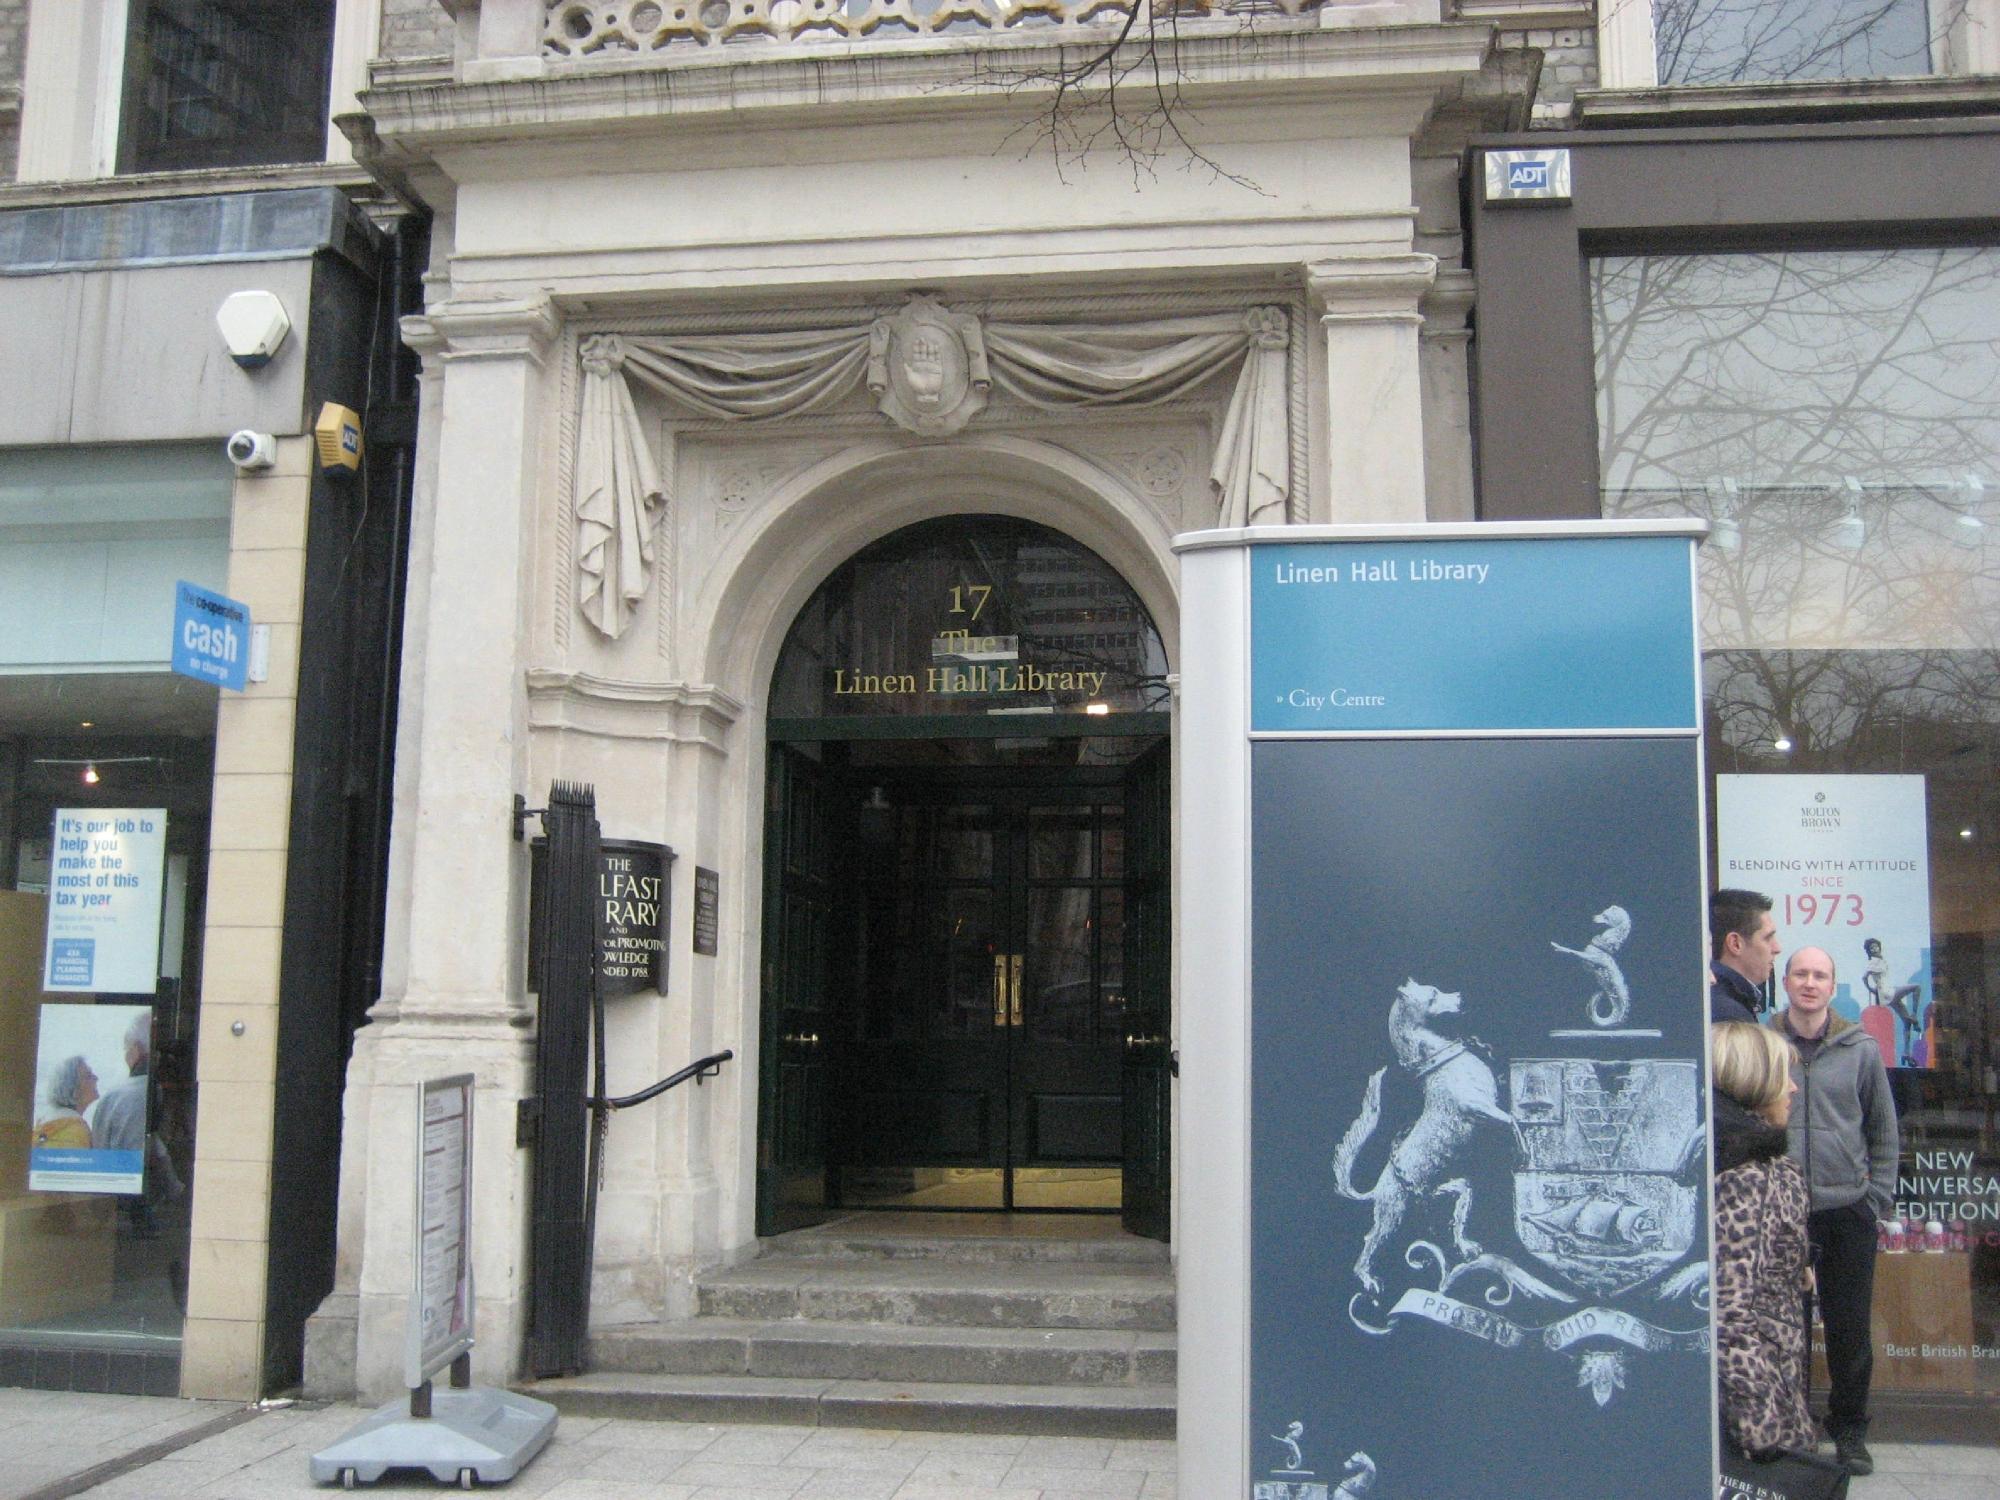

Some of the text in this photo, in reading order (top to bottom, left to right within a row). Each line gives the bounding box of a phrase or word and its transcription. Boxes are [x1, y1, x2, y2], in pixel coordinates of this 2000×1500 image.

[1510, 167, 1547, 184] ADT
[1276, 560, 1489, 584] Linen Hall Library
[948, 586, 992, 621] 17
[184, 619, 238, 662] cash
[941, 629, 996, 653] The
[834, 664, 1107, 696] Linen Hall Library
[1289, 688, 1385, 711] City Centre
[1801, 807, 1840, 817] MOLTON
[62, 819, 153, 835] It's our job to
[1801, 818, 1841, 827] BROWN
[60, 837, 118, 854] help you
[58, 856, 122, 869] make the
[606, 858, 631, 872] THE
[1729, 860, 1917, 871] BLENDING WITH ATTITUDE
[57, 873, 139, 888] most of this
[1801, 876, 1844, 888] SINCE
[56, 892, 112, 908] tax year
[1785, 894, 1865, 926] 1973
[1915, 1151, 1975, 1170] NEW
[1922, 1343, 1967, 1358] British
